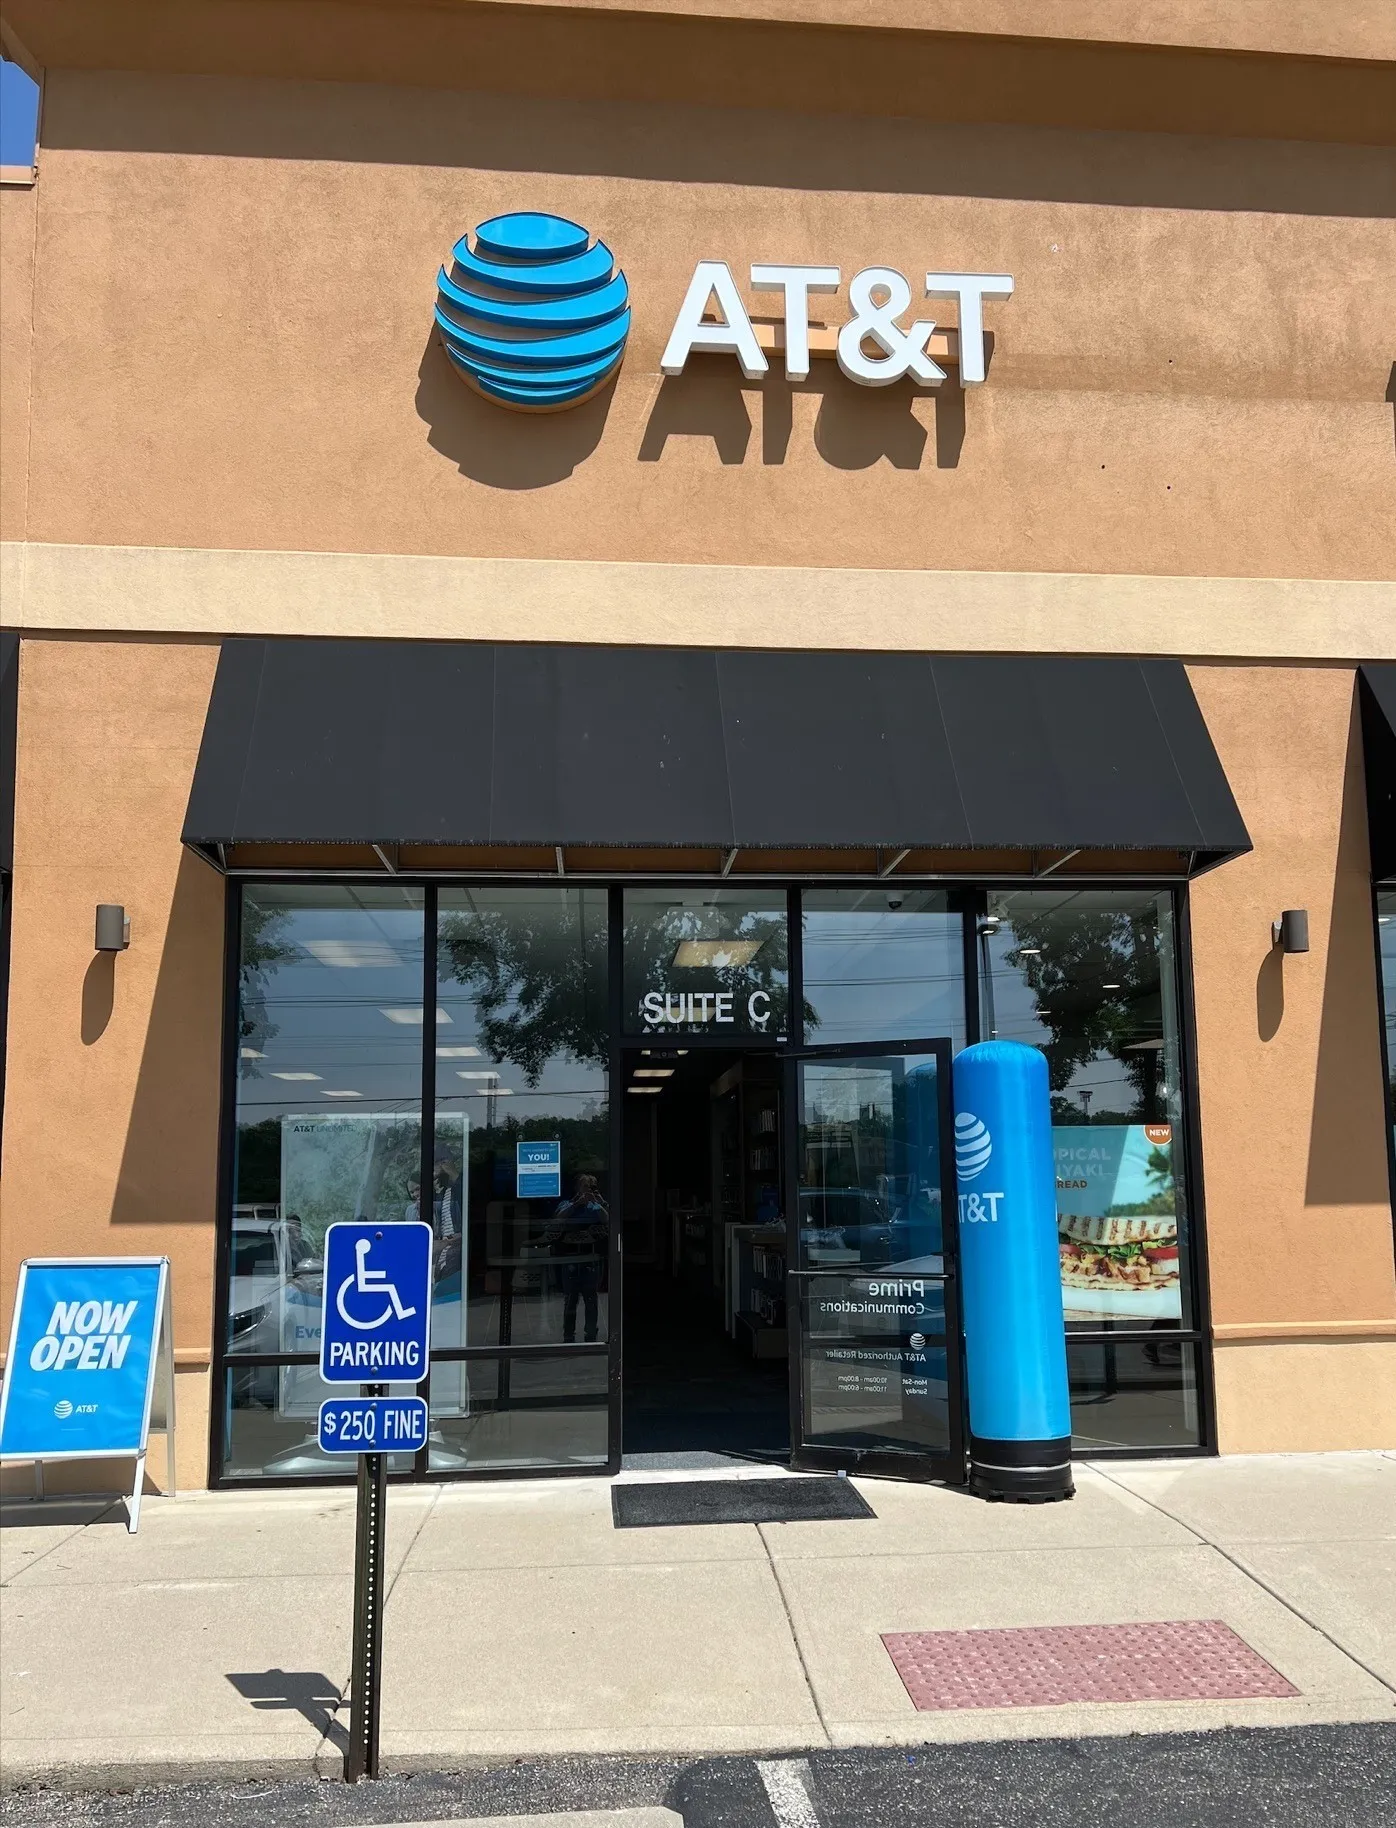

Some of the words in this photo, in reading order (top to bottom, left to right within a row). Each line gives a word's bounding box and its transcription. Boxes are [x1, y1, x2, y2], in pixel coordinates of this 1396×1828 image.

[660, 260, 1015, 388] AT&T
[643, 991, 735, 1024] SUITE
[747, 990, 771, 1023] C
[293, 1125, 315, 1133] AT&T
[1149, 1129, 1170, 1137] NEW
[527, 1153, 550, 1162] YOU!
[1053, 1147, 1112, 1161] PICAL
[1055, 1180, 1088, 1189] READ
[958, 1192, 1004, 1224] T&T
[46, 1300, 139, 1336] NOW
[29, 1334, 132, 1372] OPEN
[329, 1341, 420, 1367] PARKING
[75, 1404, 98, 1414] AT&T
[323, 1410, 376, 1440] $250
[383, 1409, 423, 1440] FINE
